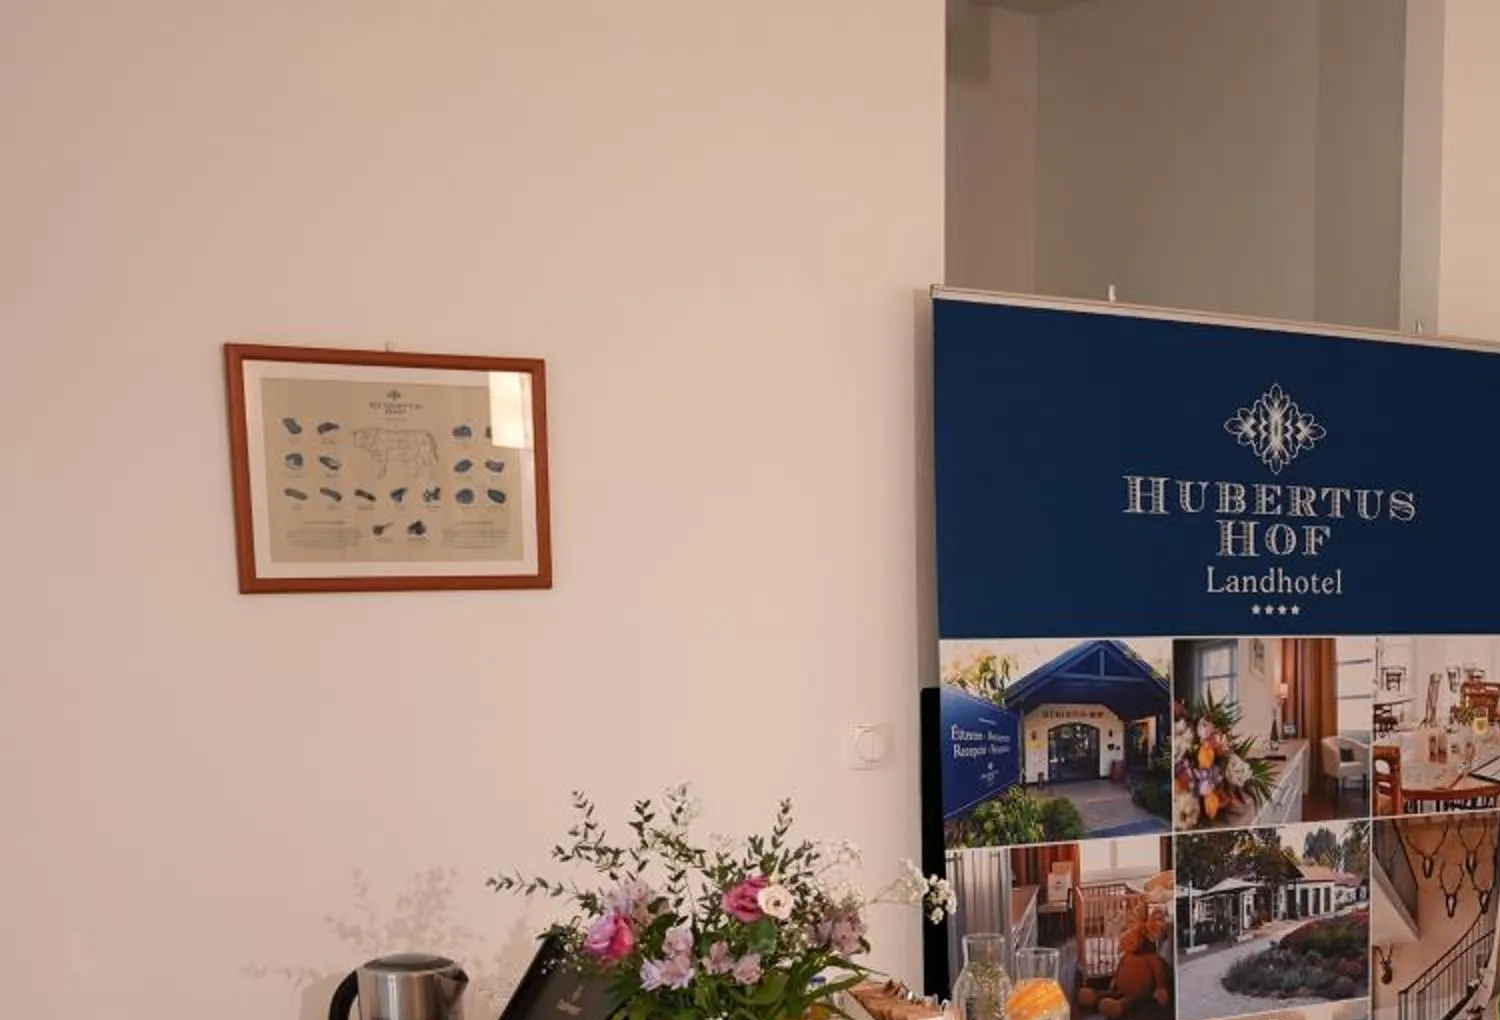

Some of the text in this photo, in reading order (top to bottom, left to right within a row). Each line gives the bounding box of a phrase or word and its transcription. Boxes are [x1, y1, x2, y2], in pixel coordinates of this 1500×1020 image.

[1121, 475, 1417, 522] HUBERTUS
[1215, 519, 1332, 557] HOF
[1206, 565, 1344, 595] Landhotel
